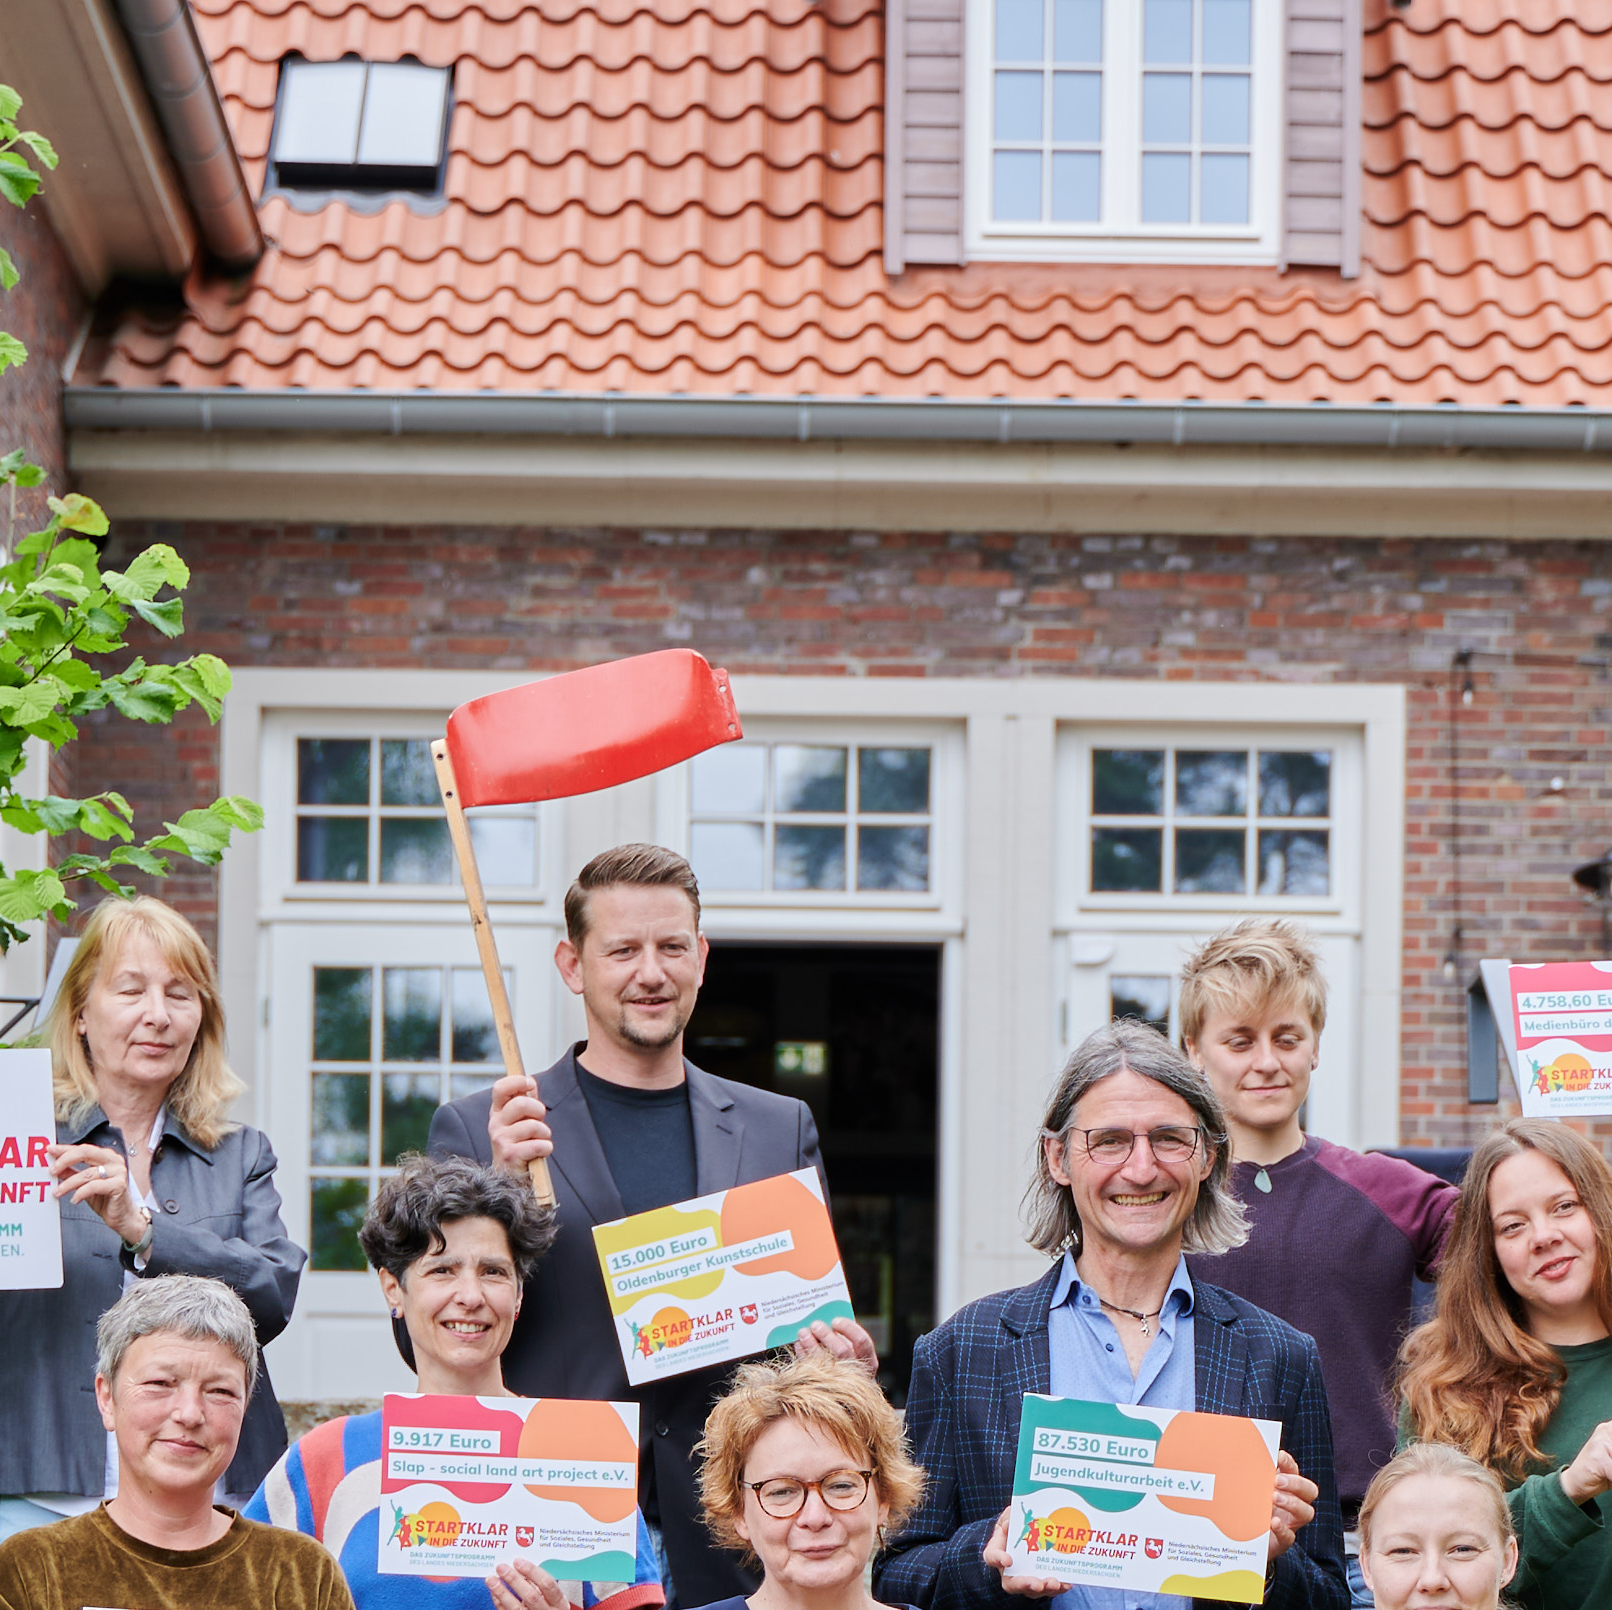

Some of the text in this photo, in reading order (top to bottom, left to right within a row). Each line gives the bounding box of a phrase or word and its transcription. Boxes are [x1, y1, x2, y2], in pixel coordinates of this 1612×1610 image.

[1522, 994, 1592, 1009] 4.758,60
[1523, 1018, 1600, 1031] Medienbüro
[1565, 1083, 1575, 1091] IN
[1576, 1082, 1591, 1091] DIE
[611, 1236, 708, 1270] 15.000 Euro
[616, 1237, 788, 1292] Oldenburger Kunstschule
[651, 1308, 733, 1339] STARTKLAR
[667, 1322, 735, 1348] IN DIE ZUKUNFT
[393, 1431, 492, 1449] 9.917 Euro
[1038, 1432, 1149, 1459] 87.530 Euro
[392, 1460, 425, 1476] Slap
[440, 1462, 481, 1475] social
[485, 1463, 518, 1477] land
[521, 1467, 543, 1478] art
[547, 1467, 598, 1482] project
[601, 1469, 628, 1481] e.V.
[1034, 1461, 1204, 1492] Jugendkulturarbeit e.V.
[415, 1519, 508, 1536] STARTKLAR
[1043, 1524, 1138, 1547] STARTKLAR
[429, 1537, 508, 1549] IN DIE ZUKUNFT
[1056, 1543, 1136, 1560] IN DIE ZUKUNFT
